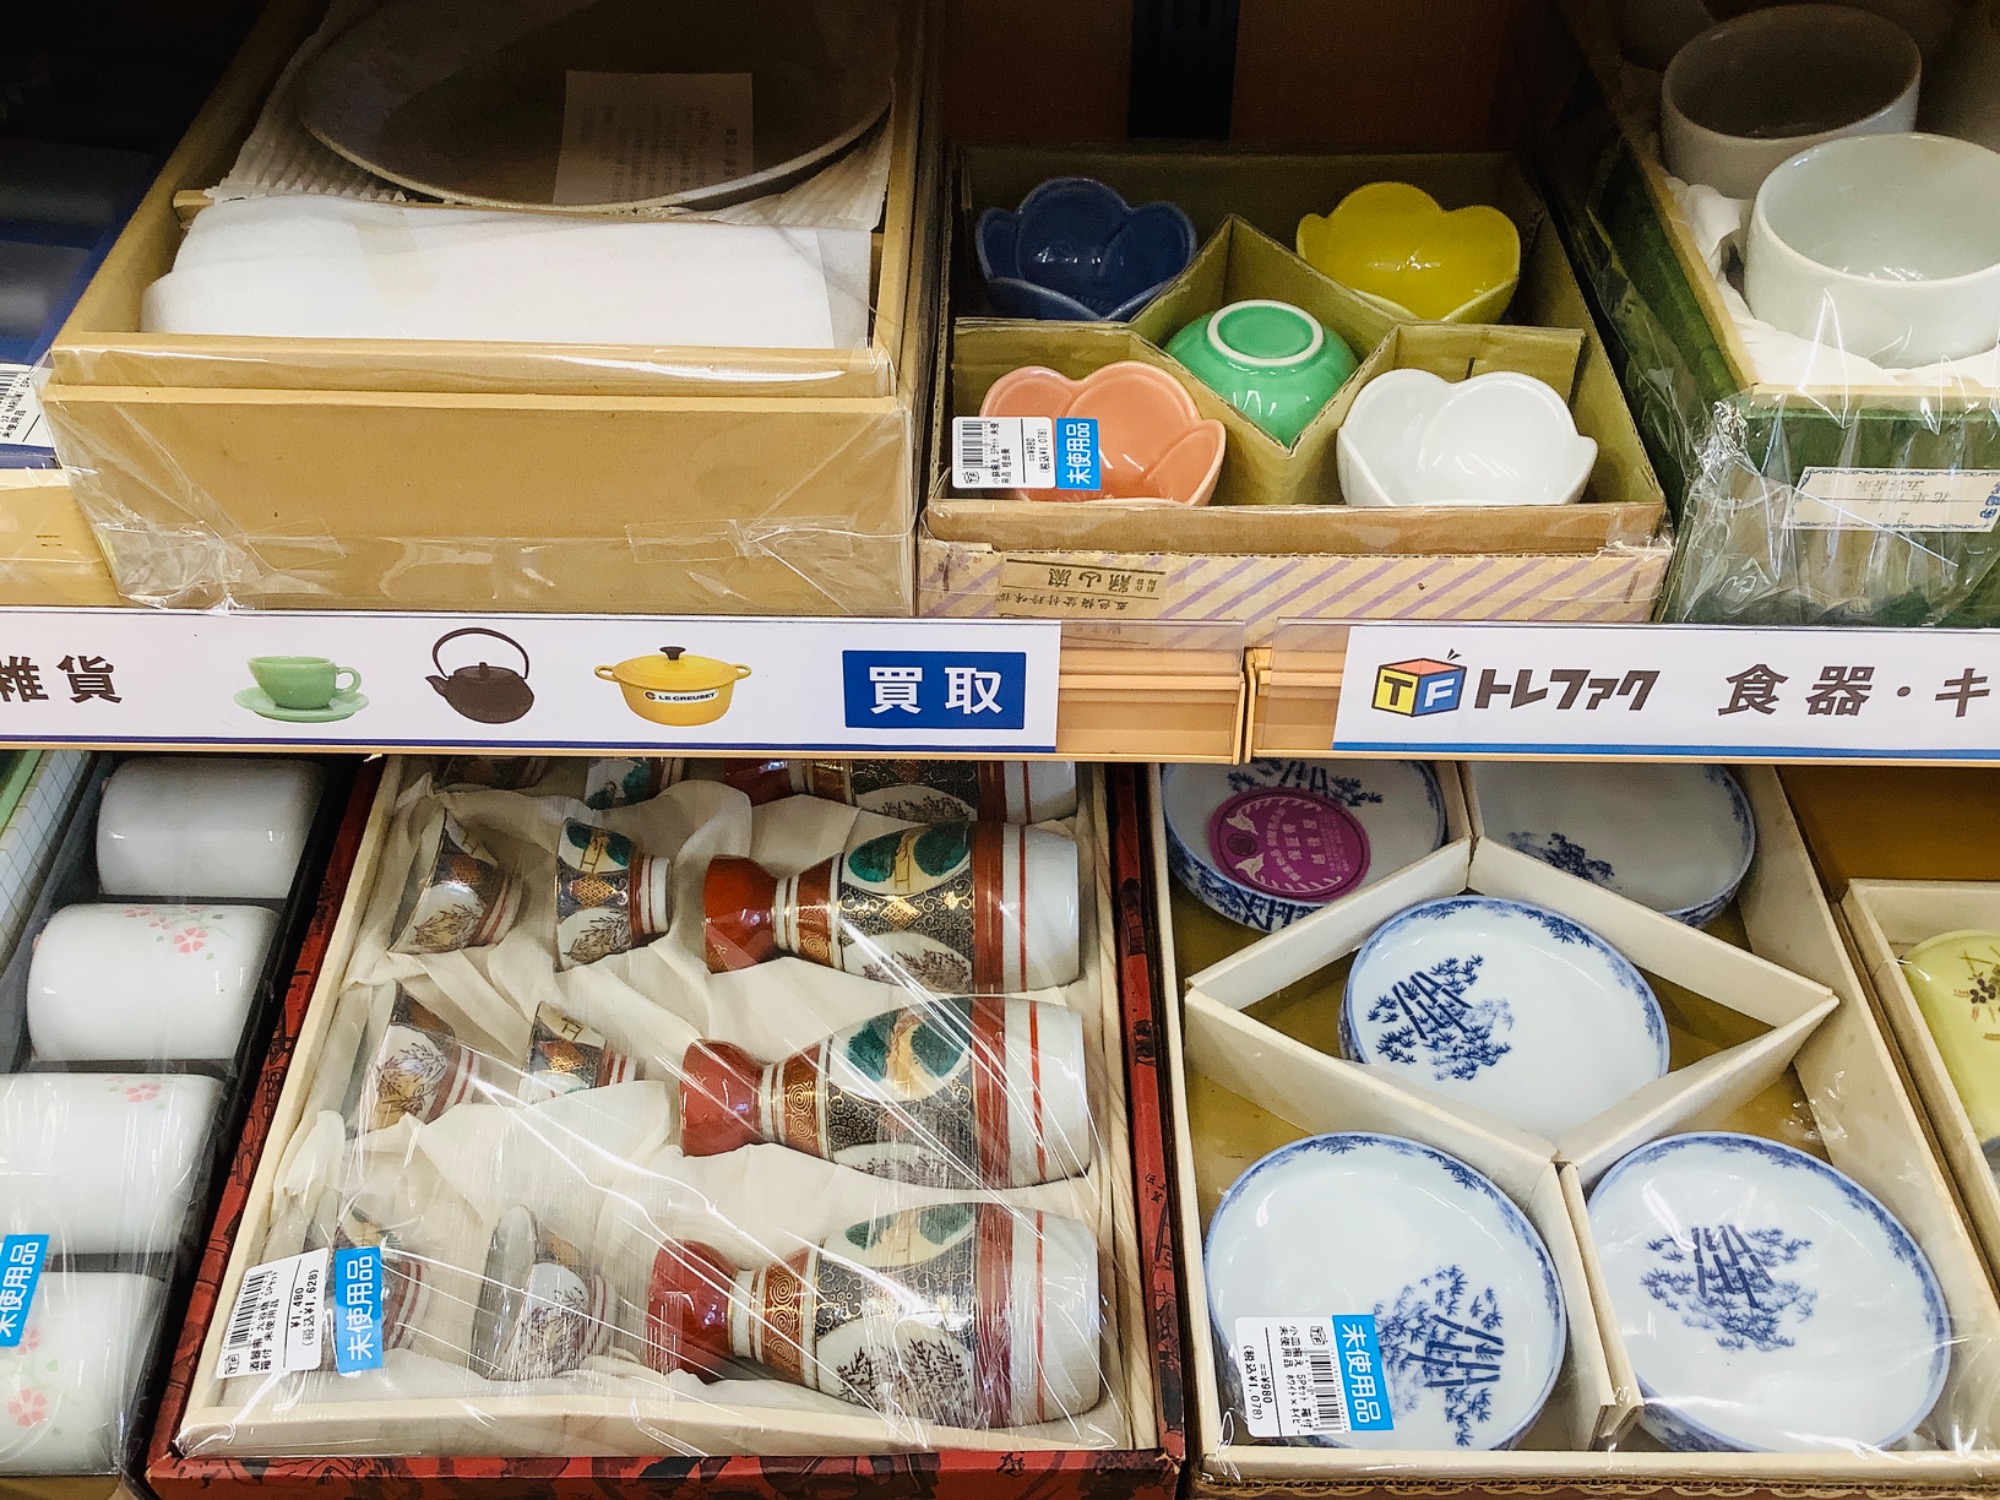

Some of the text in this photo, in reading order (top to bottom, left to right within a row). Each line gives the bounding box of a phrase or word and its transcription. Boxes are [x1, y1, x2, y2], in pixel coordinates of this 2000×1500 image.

[1066, 422, 1093, 485] 未使用品
[0, 655, 122, 704] 雑貨
[673, 692, 715, 701] CREUSET
[869, 666, 1003, 715] 買取
[1474, 669, 1661, 711] トレファク
[264, 1298, 279, 1342] 未使用品
[290, 1287, 304, 1329] ¥1,480
[302, 1269, 319, 1347] (税込¥1,628)
[346, 1255, 375, 1361] 未使用品
[1278, 1325, 1294, 1369] 未使用品
[1243, 1345, 1263, 1421] (税込¥1,078)
[1341, 1323, 1382, 1424] 未使用品
